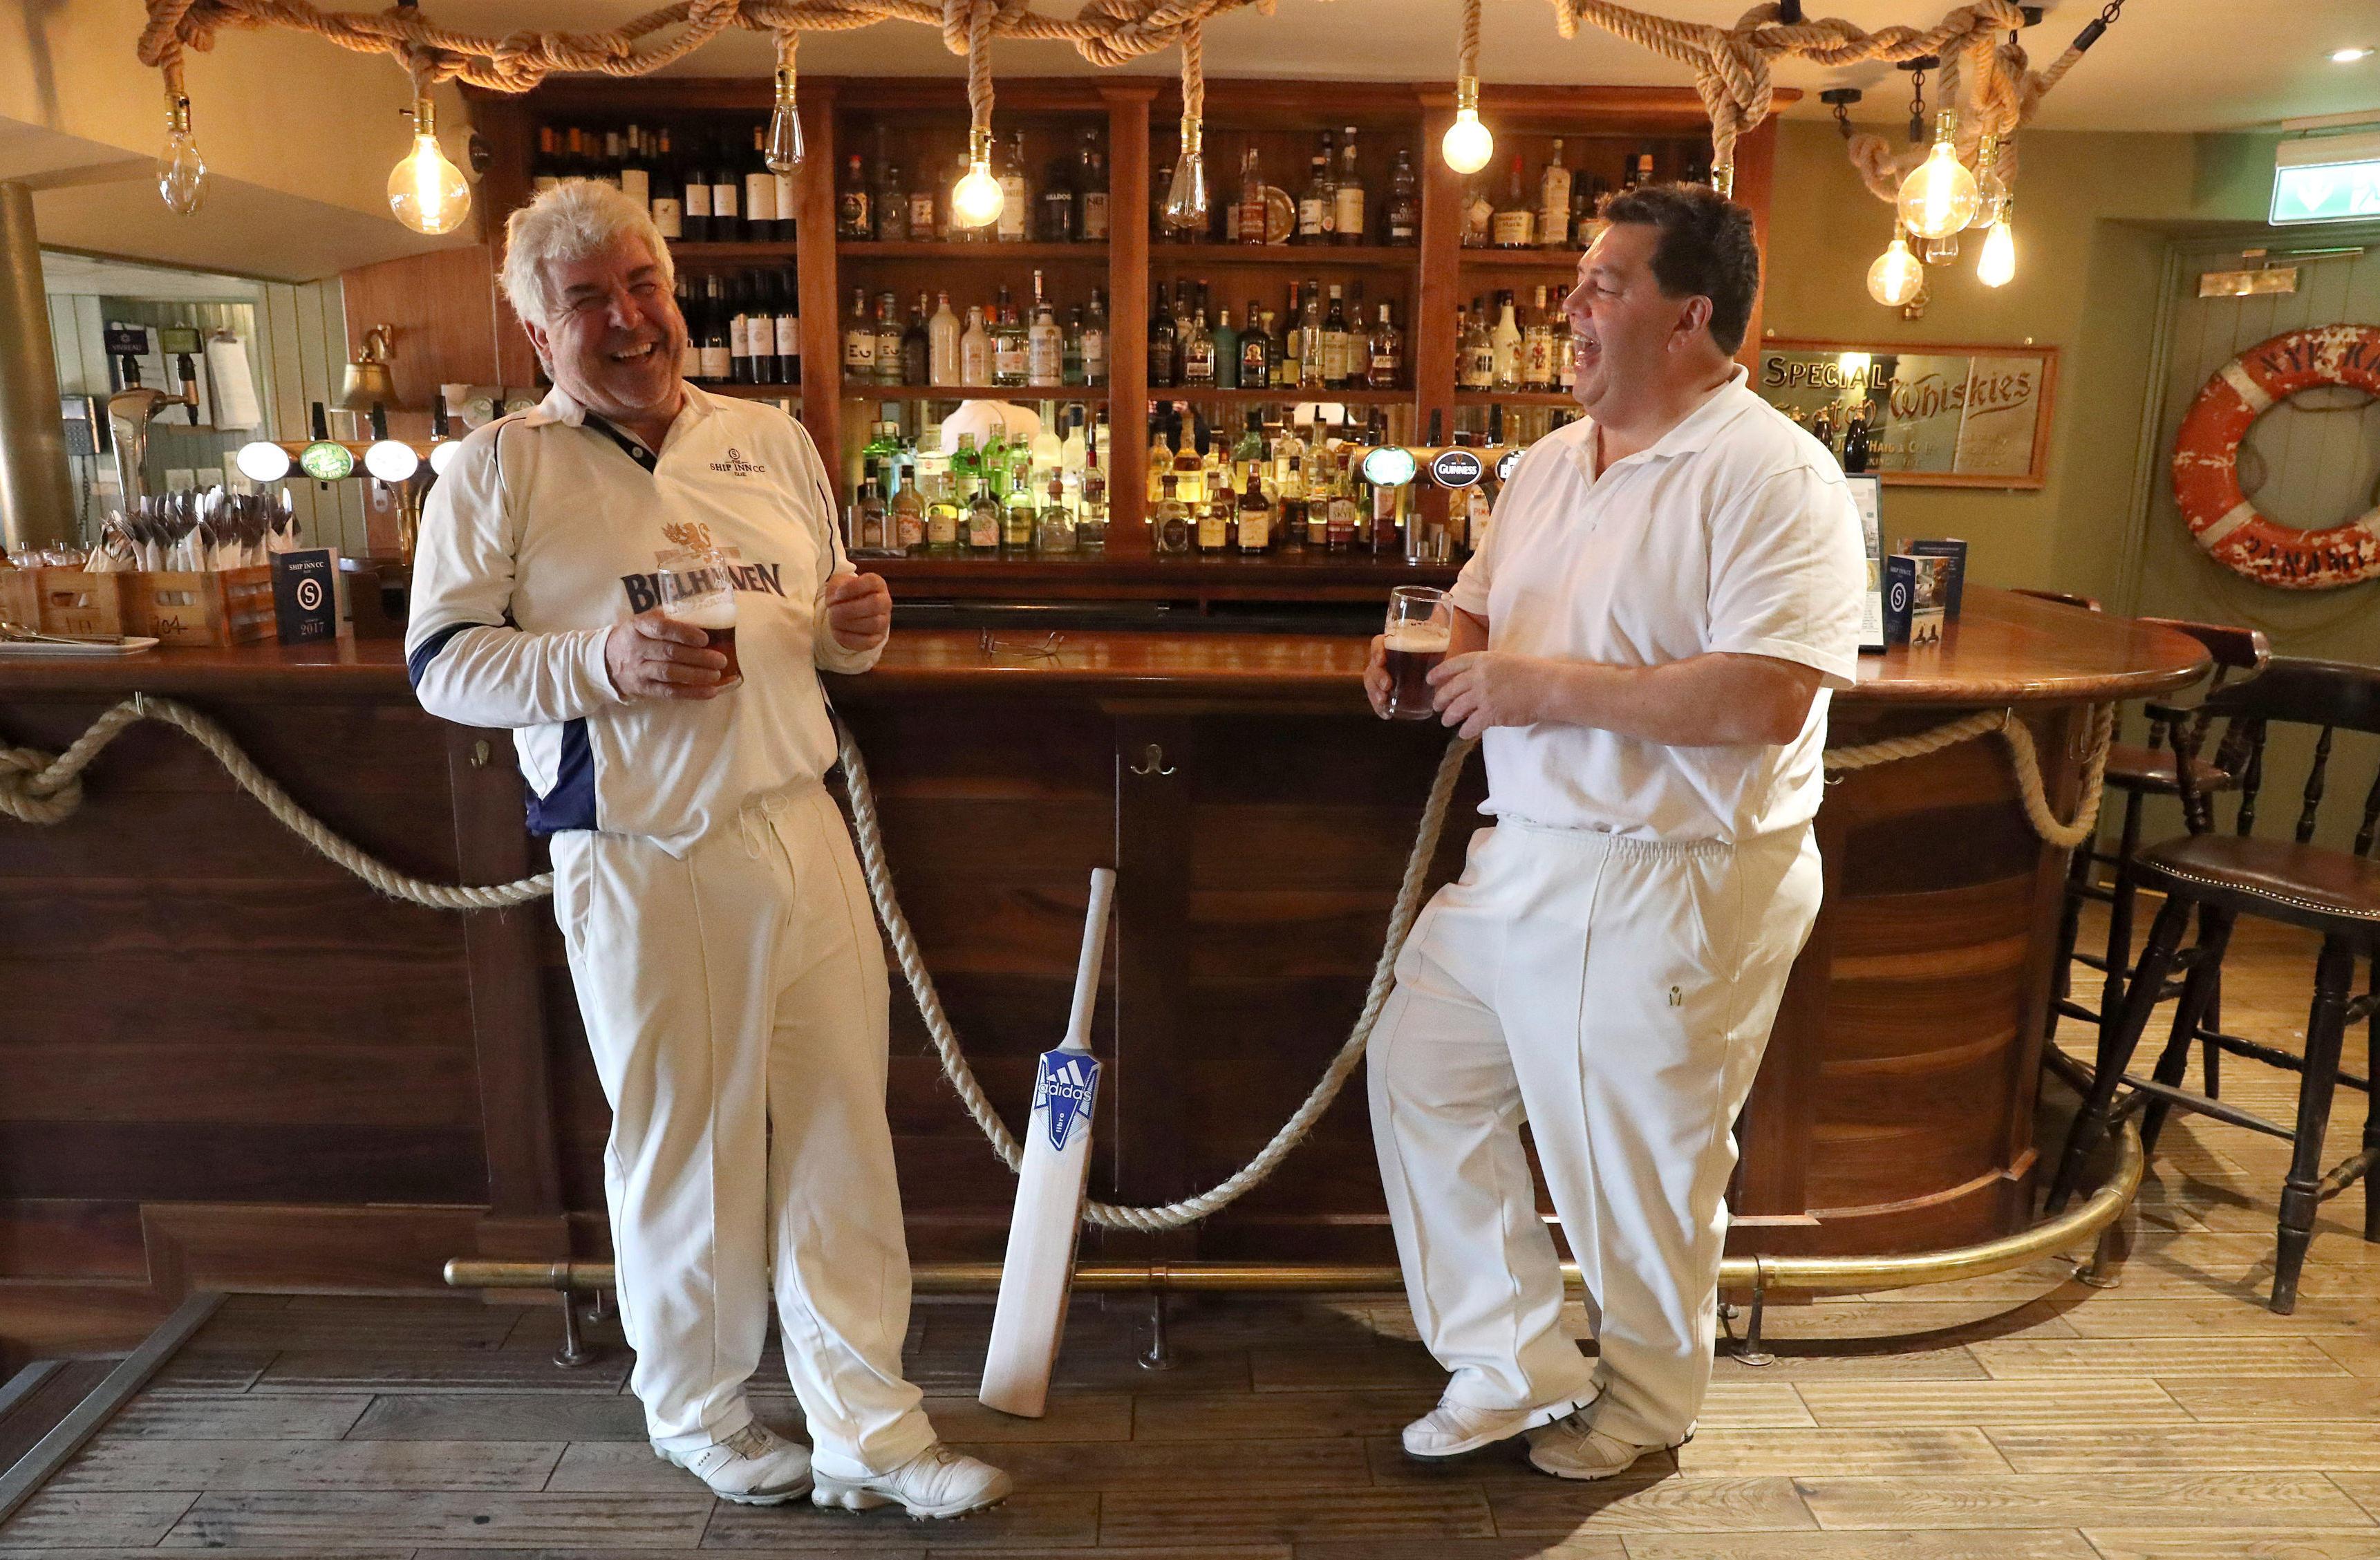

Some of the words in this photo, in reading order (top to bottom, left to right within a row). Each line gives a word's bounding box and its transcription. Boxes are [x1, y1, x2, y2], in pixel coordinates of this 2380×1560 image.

[1763, 356, 1888, 389] SPECIAL
[1889, 372, 2032, 421] Whiskies
[709, 462, 731, 471] SHIP
[1438, 463, 1478, 476] GUINNESS
[300, 621, 325, 636] 2017
[1038, 1082, 1091, 1102] adidas
